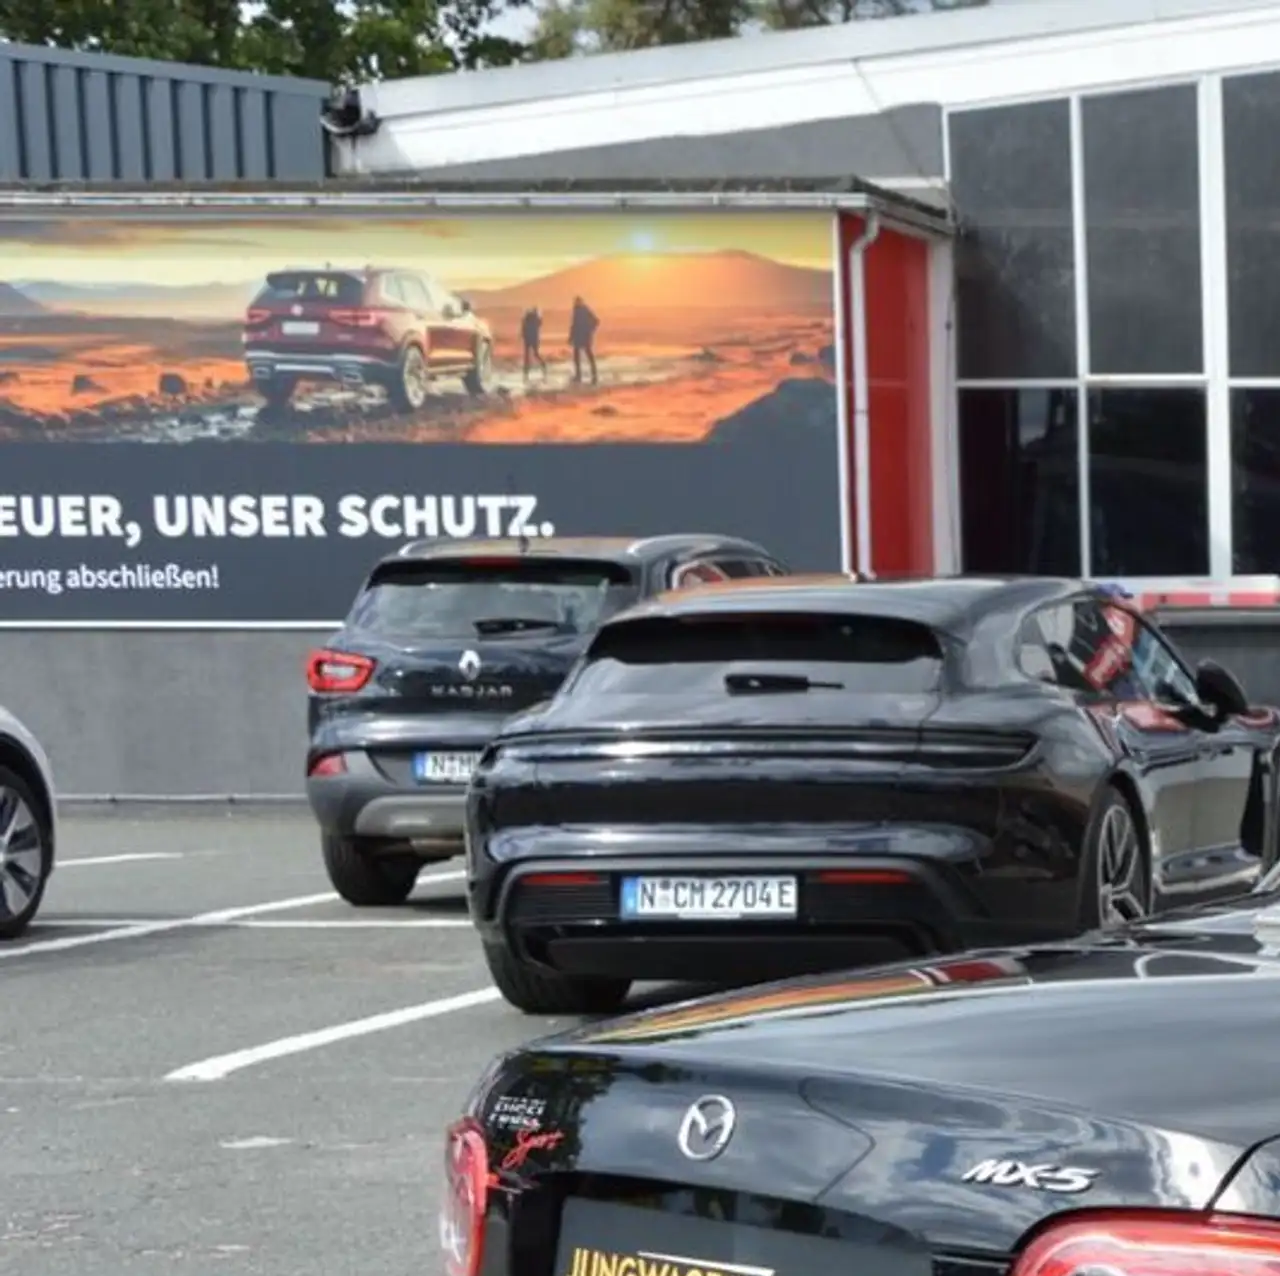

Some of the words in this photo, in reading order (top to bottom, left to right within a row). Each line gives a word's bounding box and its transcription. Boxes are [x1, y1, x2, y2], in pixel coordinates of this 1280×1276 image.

[0, 494, 142, 547] EUER,
[153, 494, 327, 537] UNSER
[338, 494, 555, 537] SCHUTZ.
[66, 563, 220, 589] abschließen!
